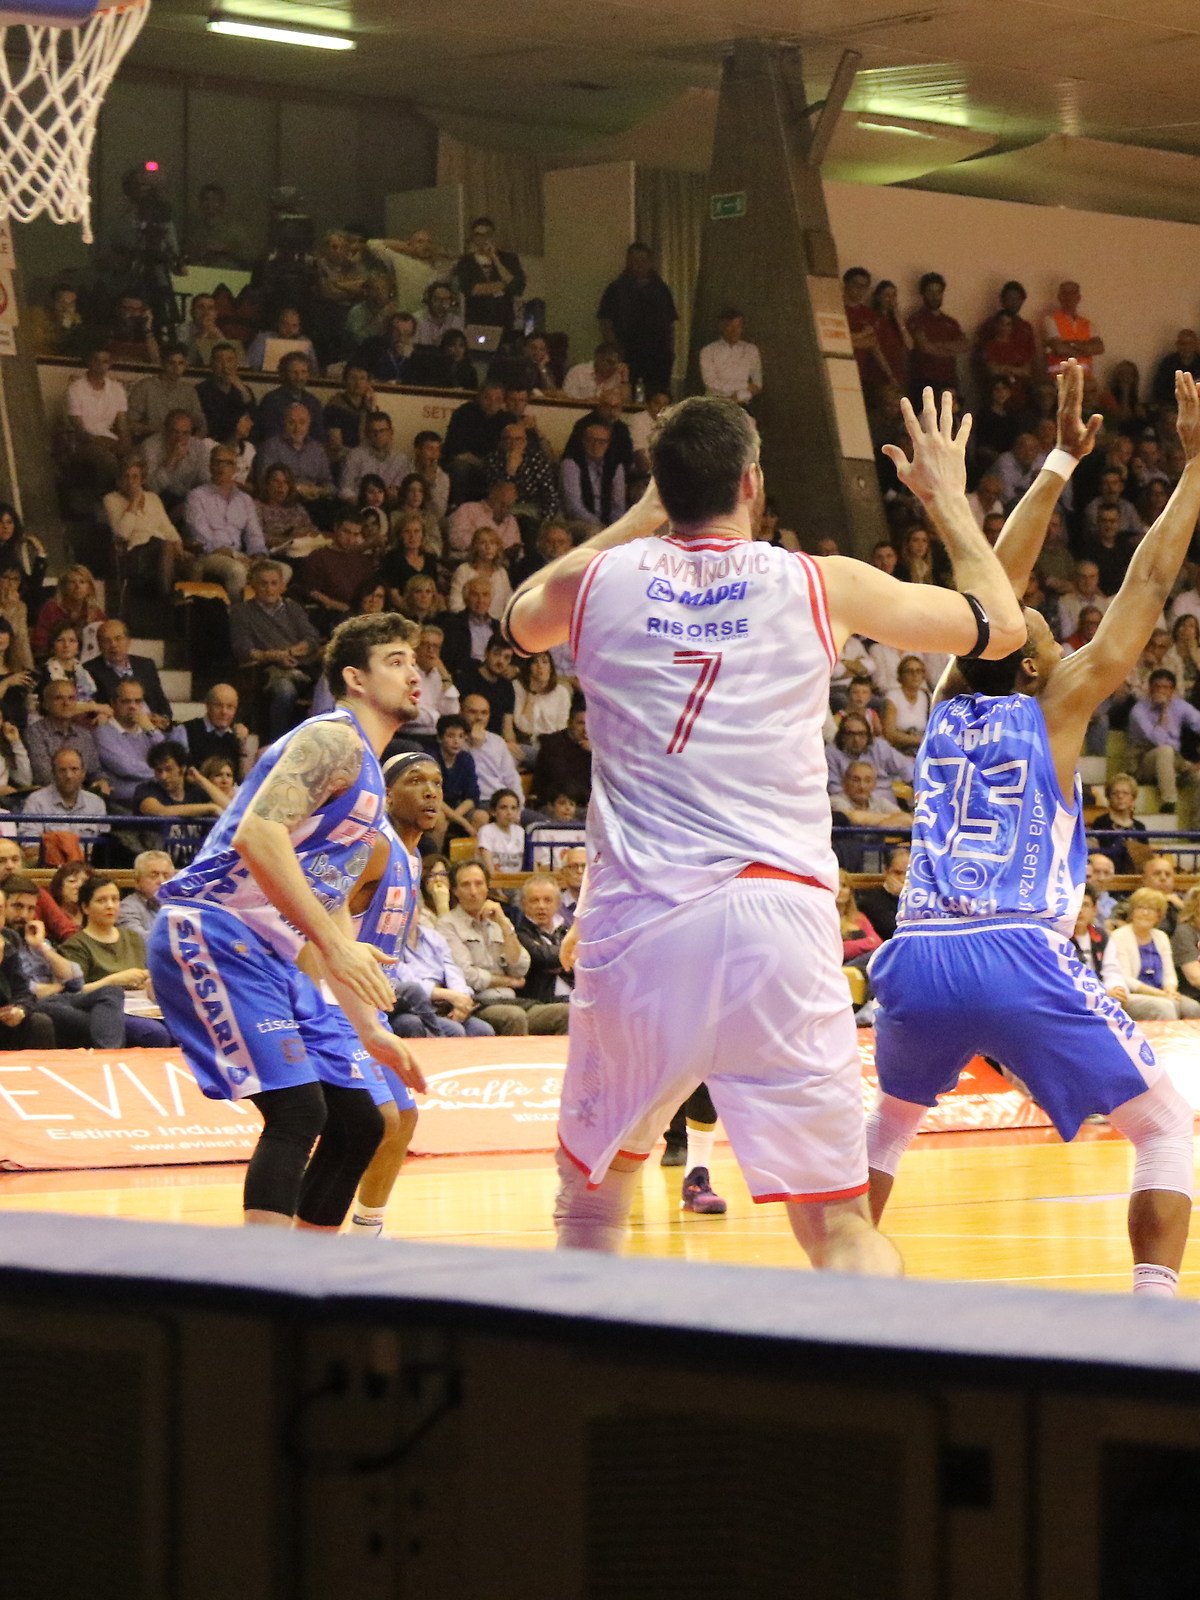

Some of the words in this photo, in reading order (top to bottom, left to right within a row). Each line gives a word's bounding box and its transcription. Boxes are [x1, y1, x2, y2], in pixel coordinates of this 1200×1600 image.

[678, 581, 748, 607] MAPEI
[646, 617, 749, 638] RISORSE
[666, 650, 722, 755] 7
[176, 918, 241, 1057] SASSARI
[46, 1127, 151, 1141] Estimo
[157, 1122, 264, 1137] Industri
